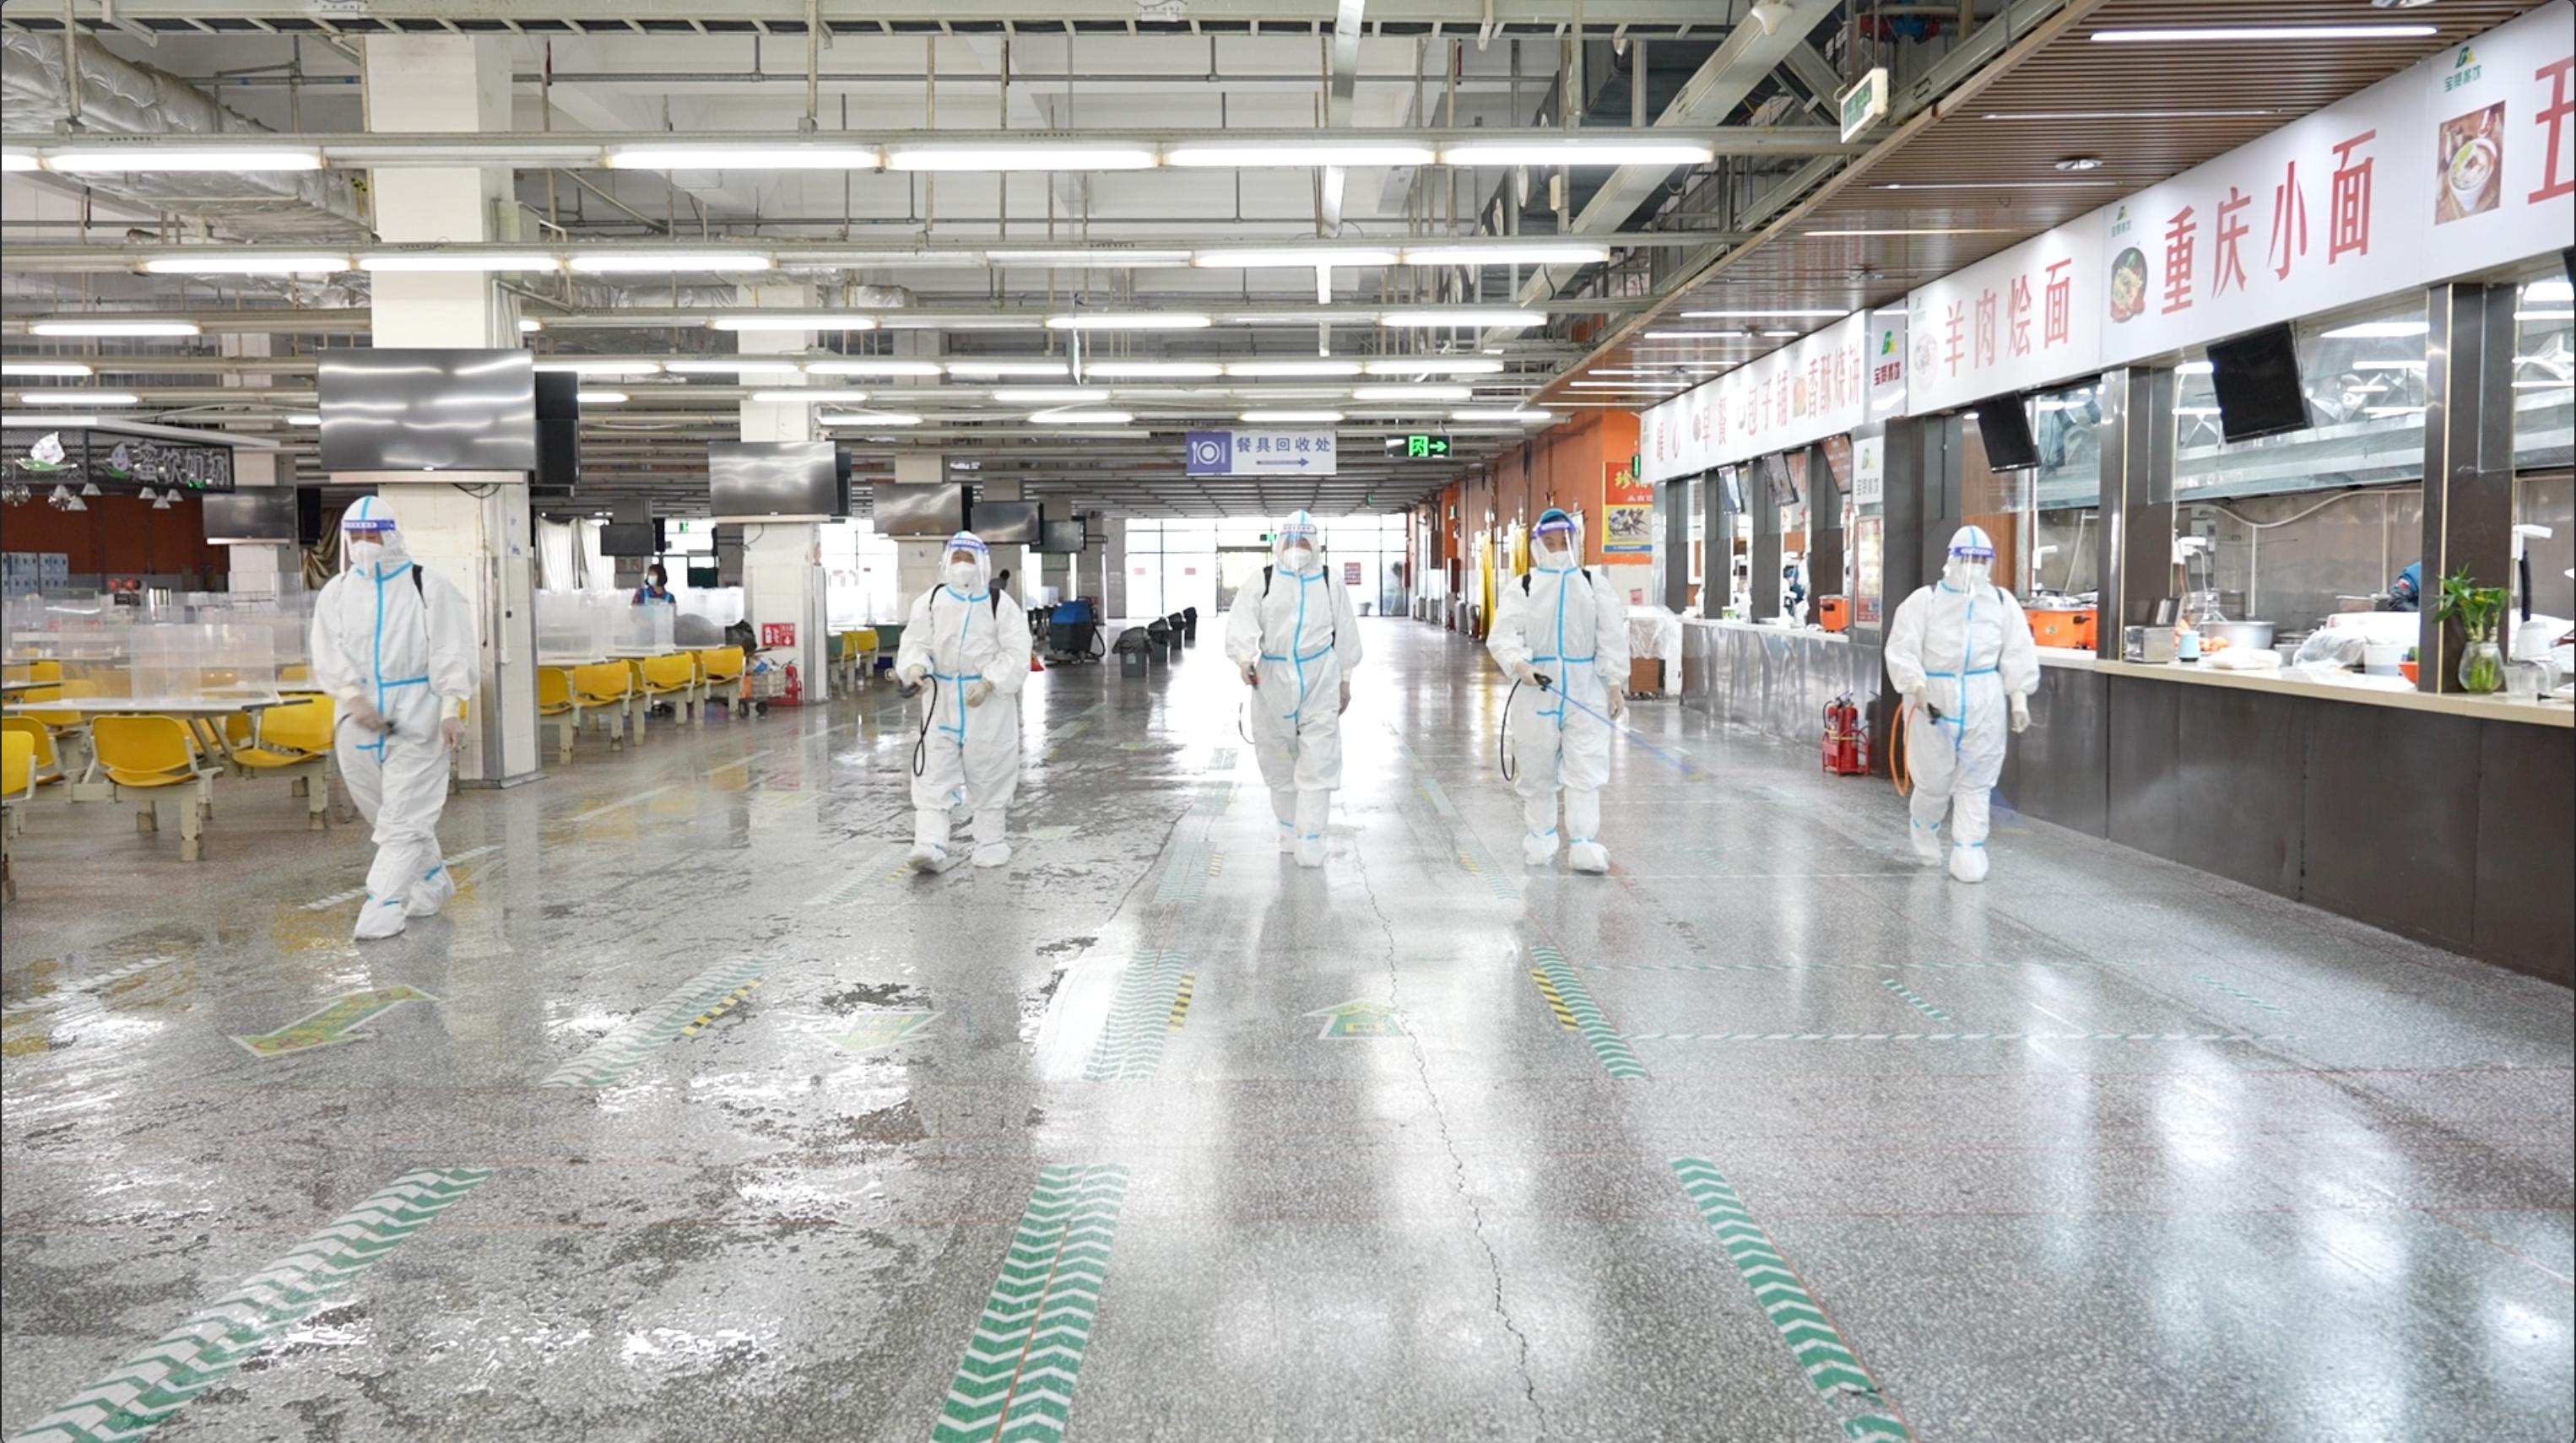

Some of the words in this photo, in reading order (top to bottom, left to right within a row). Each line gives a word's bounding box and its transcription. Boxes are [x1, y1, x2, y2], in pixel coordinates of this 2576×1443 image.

[2528, 55, 2574, 204] 五
[2162, 129, 2377, 315] 重庆小面
[1944, 258, 2072, 377] 羊肉烩面
[1236, 436, 1331, 453] 餐具回收处
[1748, 370, 1789, 436] 包子铺
